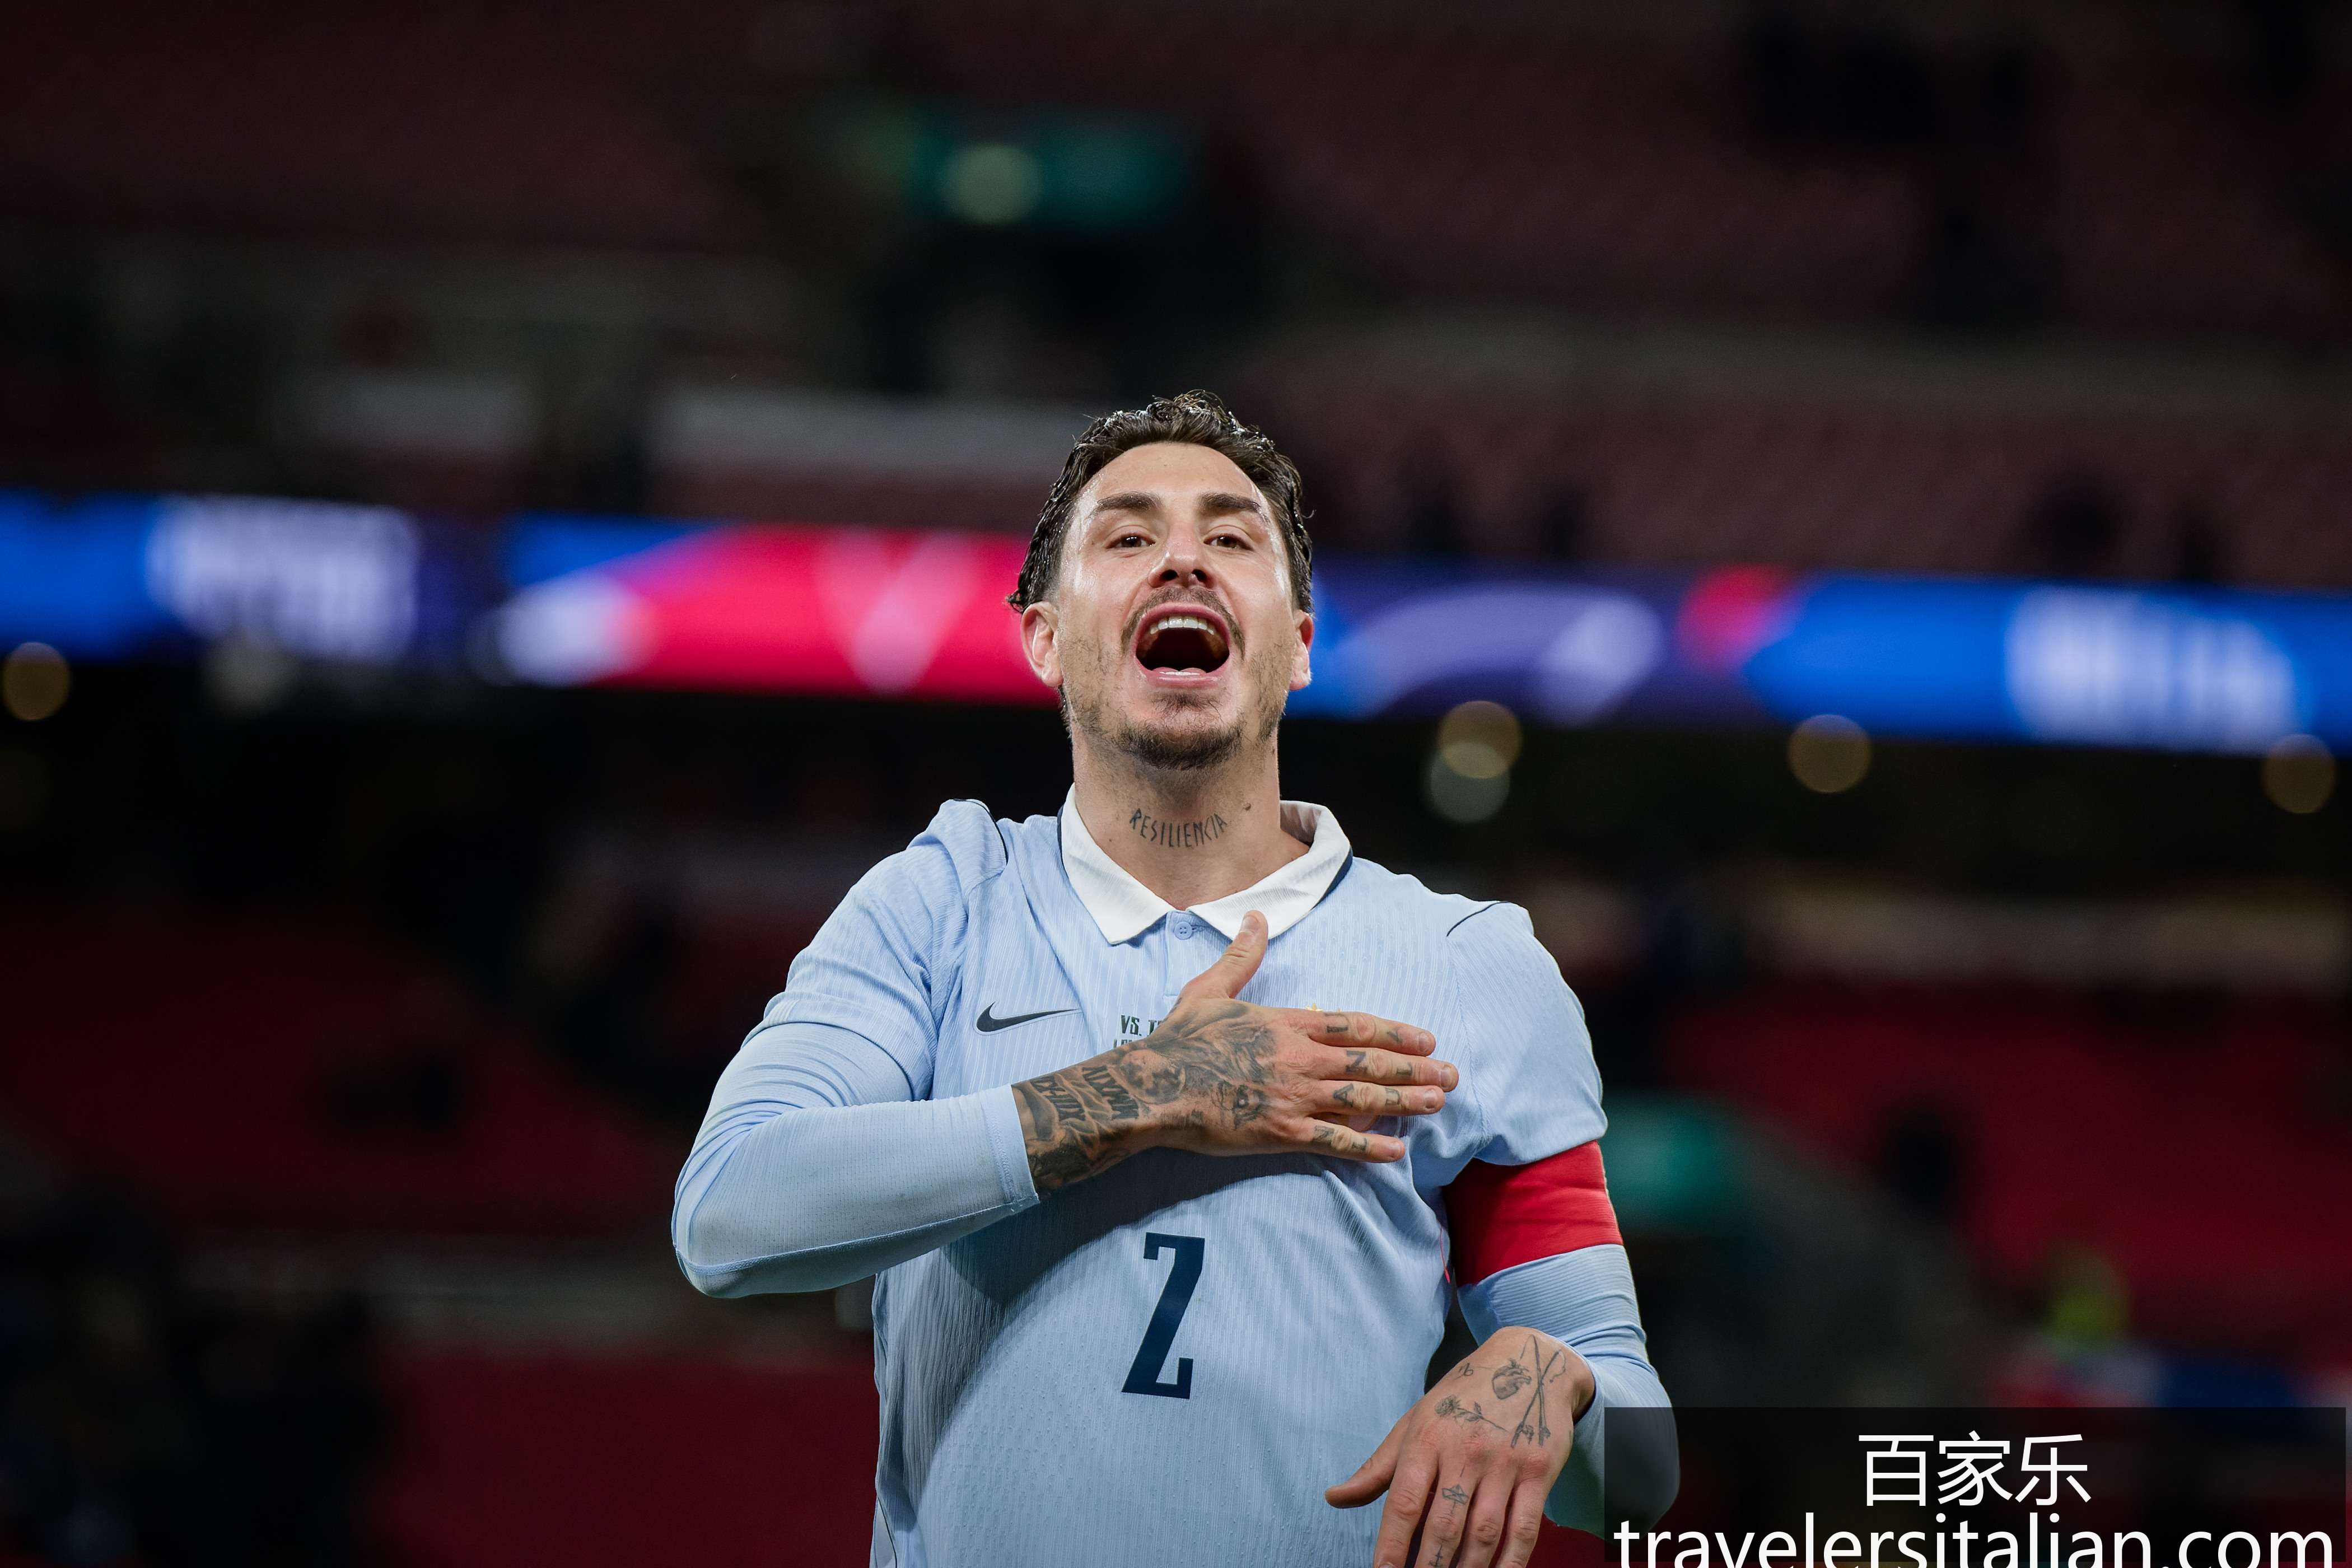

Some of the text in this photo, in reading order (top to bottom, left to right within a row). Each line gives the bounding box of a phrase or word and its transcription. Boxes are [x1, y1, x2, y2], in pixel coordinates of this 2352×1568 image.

[1129, 808, 1228, 847] RESILIENCIA
[1121, 1015, 1142, 1036] VS.
[1121, 1232, 1205, 1399] 2
